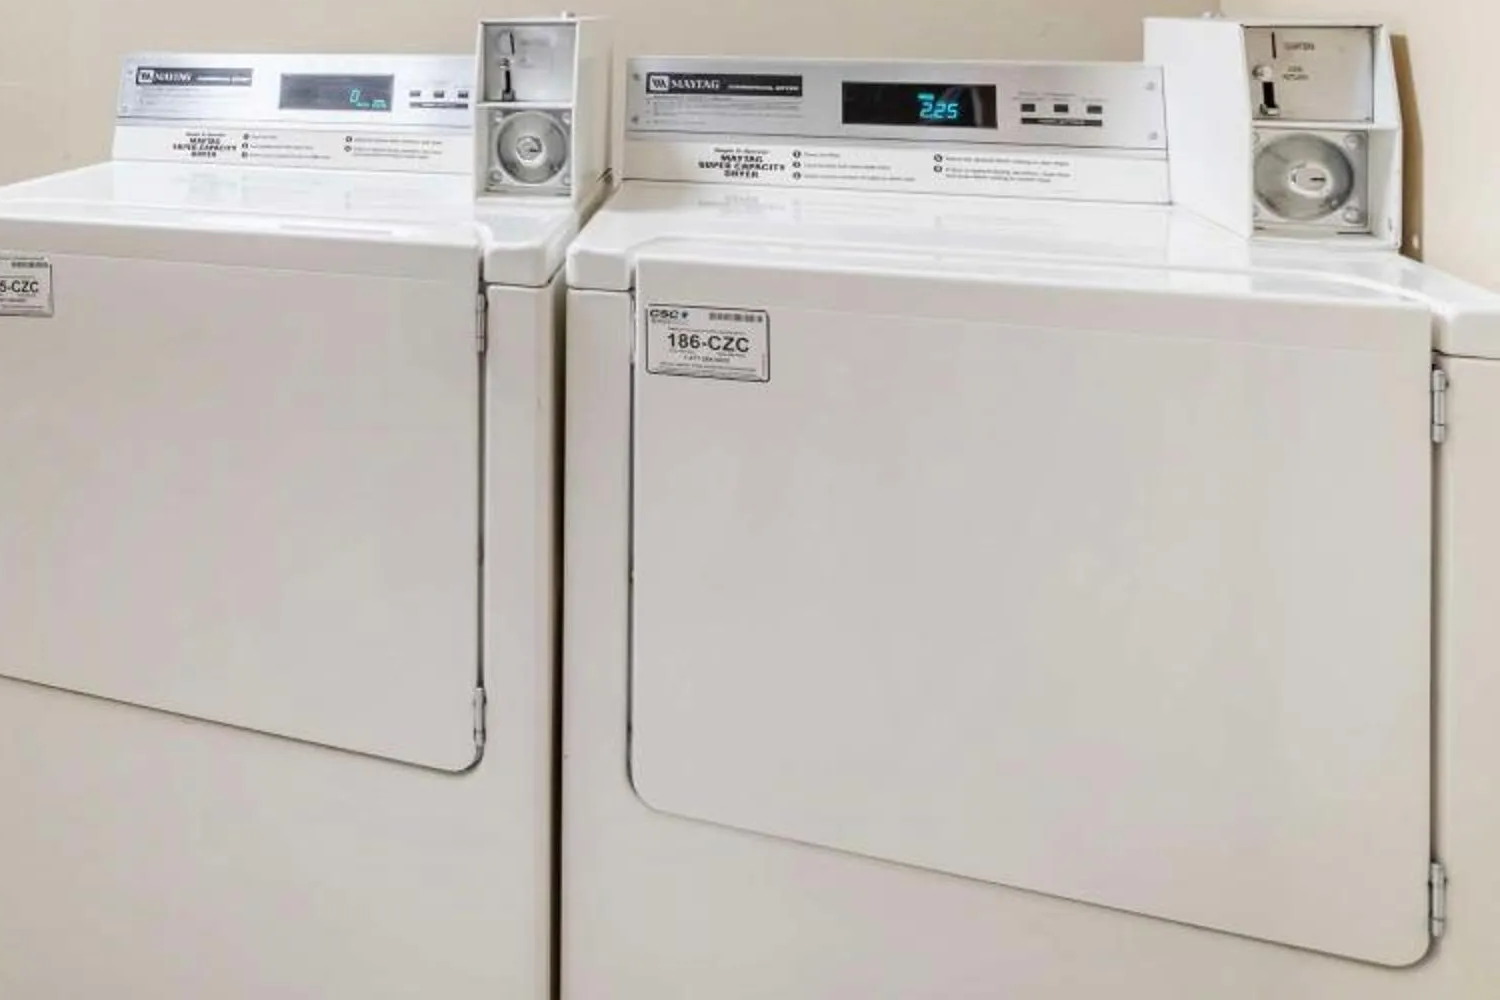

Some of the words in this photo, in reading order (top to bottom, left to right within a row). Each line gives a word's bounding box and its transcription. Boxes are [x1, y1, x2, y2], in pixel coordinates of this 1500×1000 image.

[671, 79, 721, 91] MAYTAG
[720, 154, 763, 164] MAYTAG
[698, 161, 731, 170] SUPER
[734, 162, 786, 172] CAPACITY
[723, 170, 760, 179] DRYER
[667, 332, 750, 353] 186-CZC
